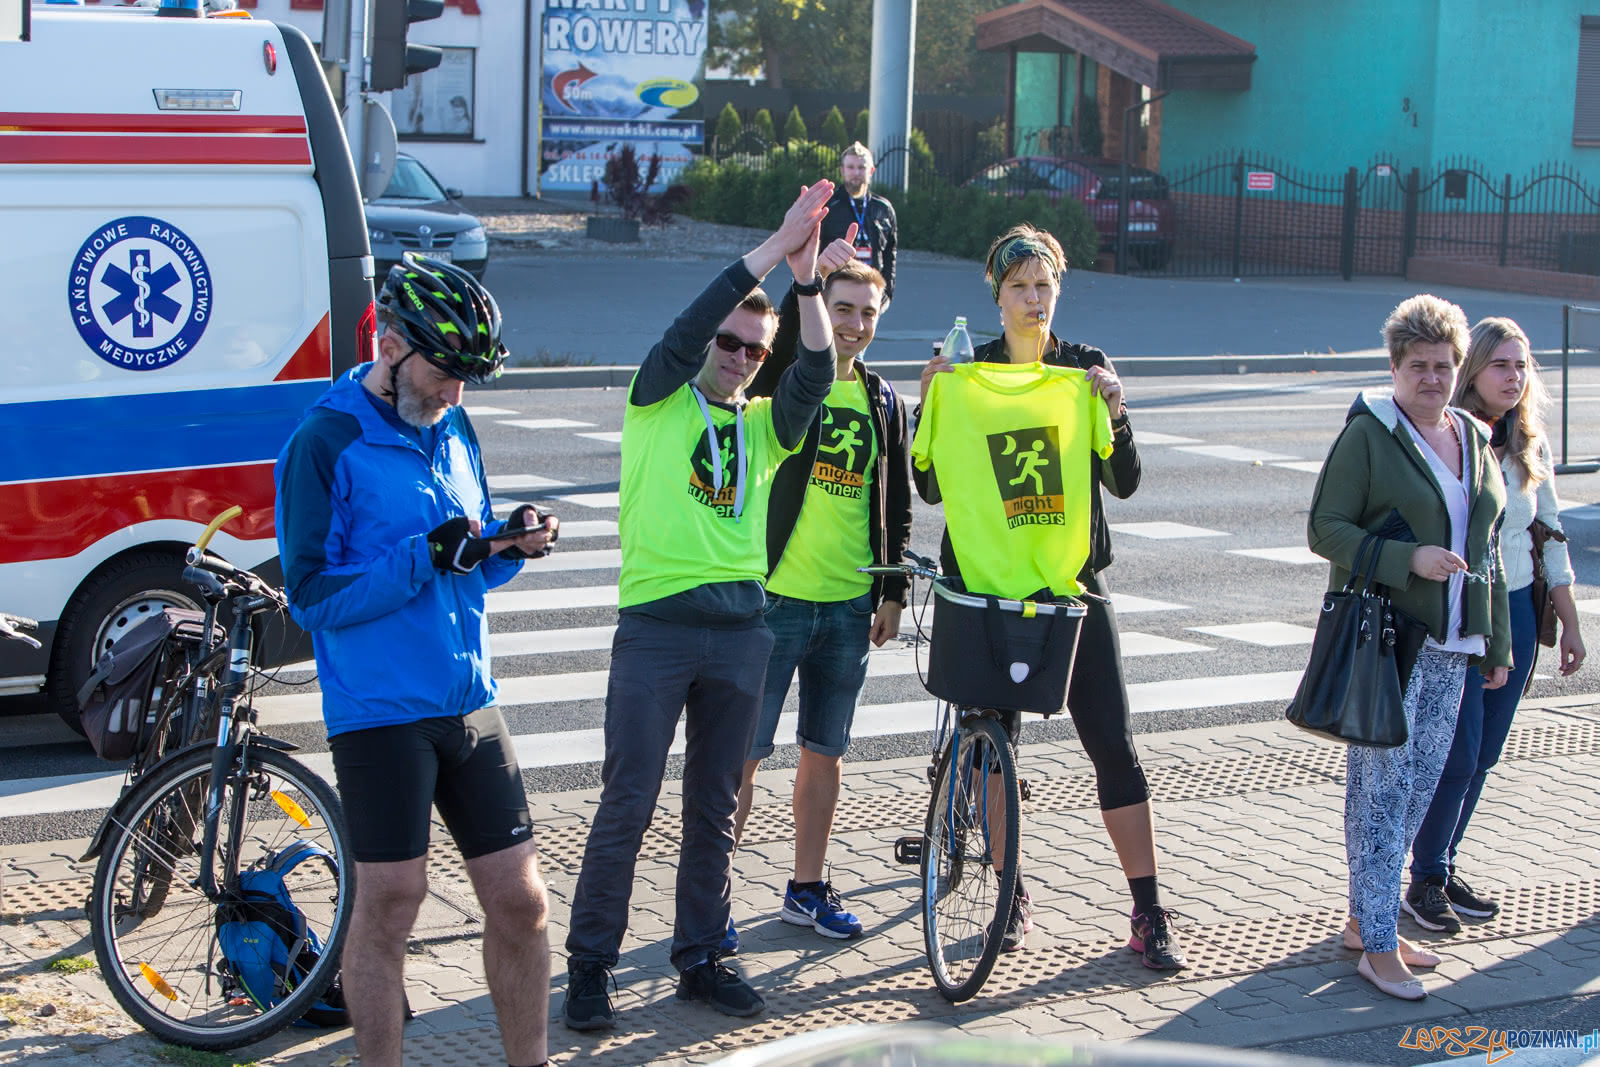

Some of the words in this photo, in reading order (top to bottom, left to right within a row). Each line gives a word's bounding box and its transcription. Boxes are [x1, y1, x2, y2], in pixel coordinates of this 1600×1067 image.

[548, 16, 703, 56] ROWERY
[72, 223, 129, 326] PAŃSTWOWE
[150, 223, 209, 322] RATOWNICTWO
[100, 337, 188, 365] MEDYCZNE
[1013, 496, 1054, 513] night
[1009, 512, 1066, 530] runners
